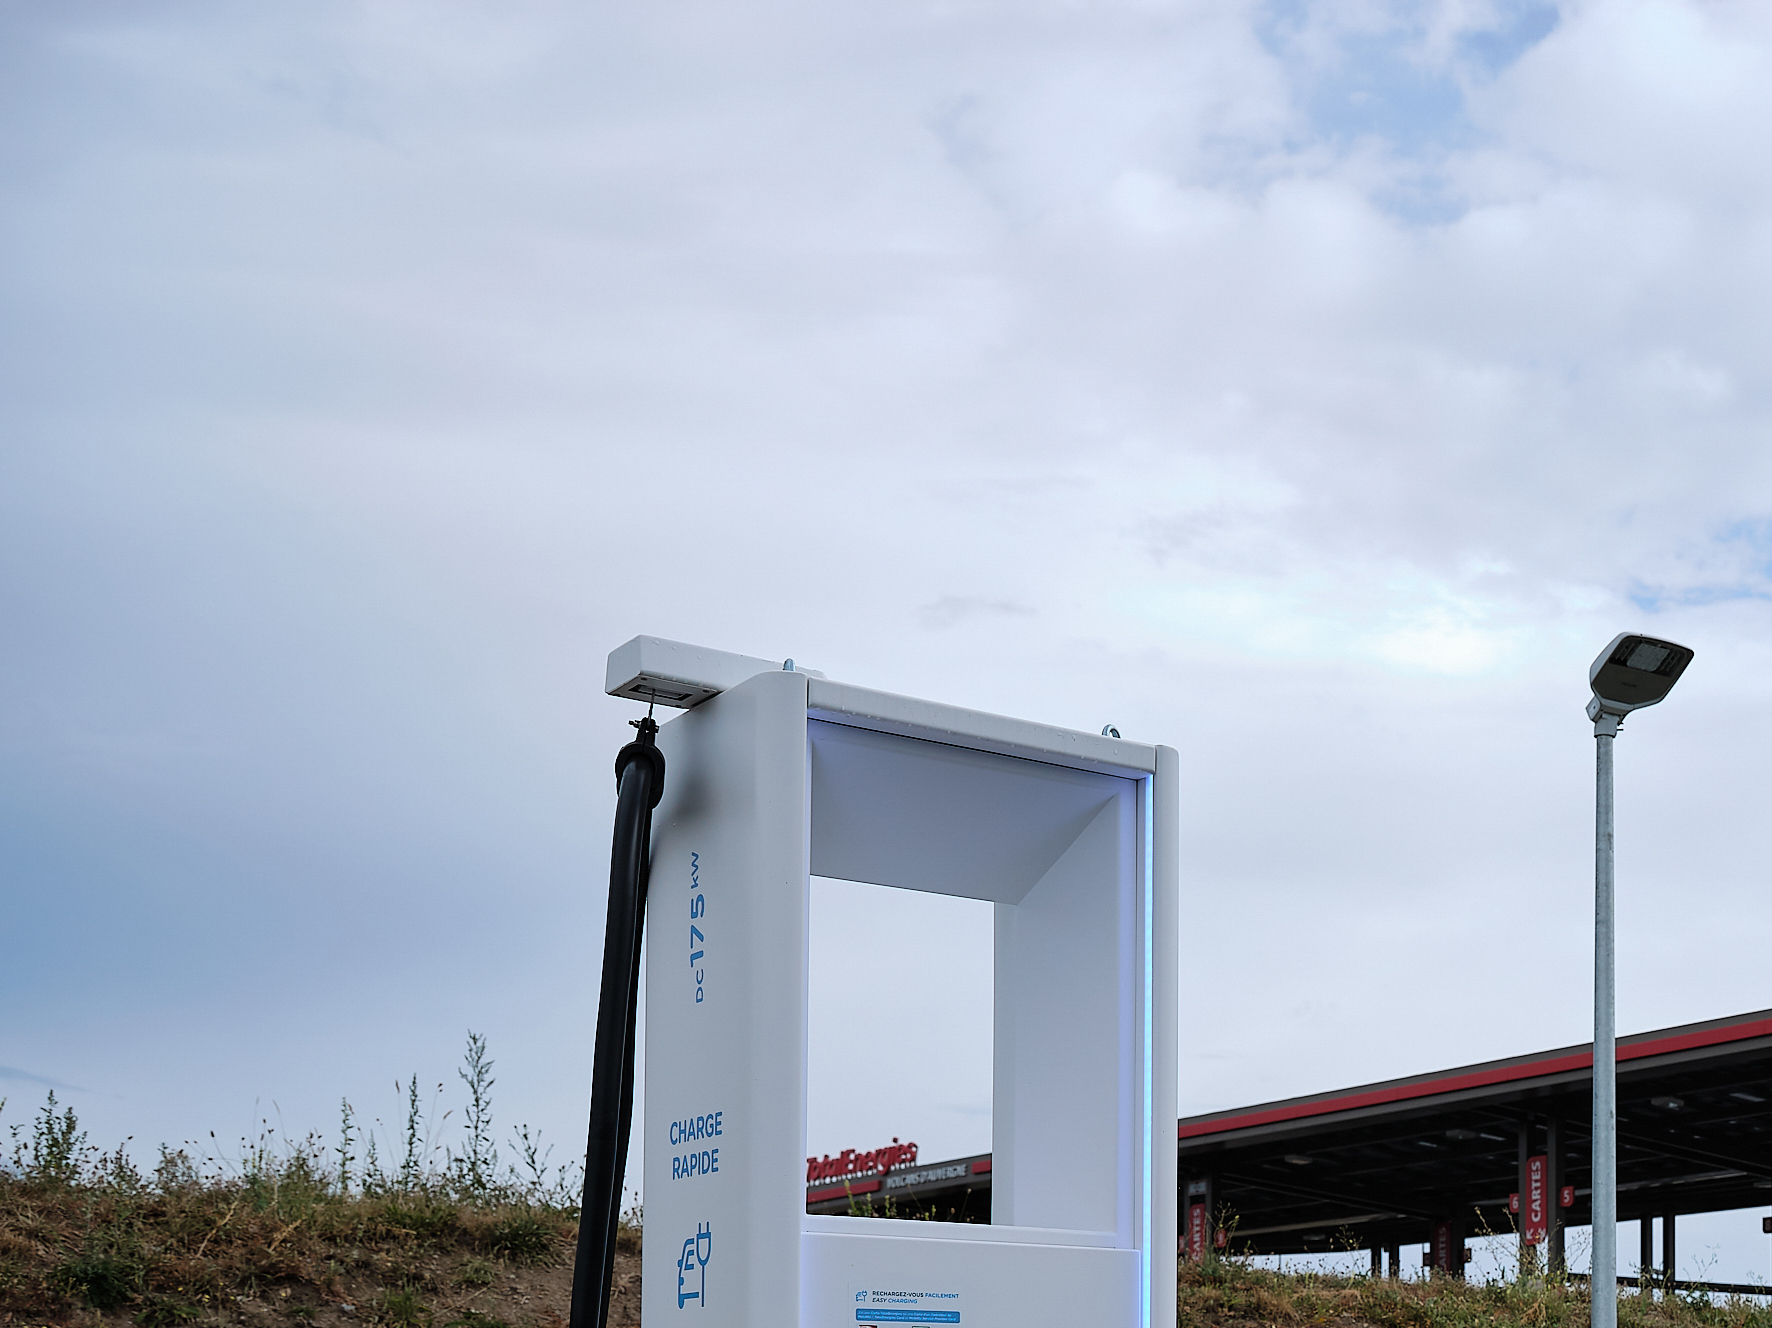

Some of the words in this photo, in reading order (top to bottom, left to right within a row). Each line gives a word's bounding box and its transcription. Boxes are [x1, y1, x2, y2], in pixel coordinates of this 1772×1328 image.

[690, 851, 699, 890] kW
[690, 893, 705, 968] 175
[695, 969, 704, 1004] DC
[669, 1111, 723, 1146] CHARGE
[672, 1149, 719, 1181] RAPIDE
[807, 1138, 917, 1181] TotalEnergies
[1512, 1197, 1519, 1209] 6
[1531, 1161, 1541, 1222] CARTES
[1564, 1190, 1570, 1202] 5
